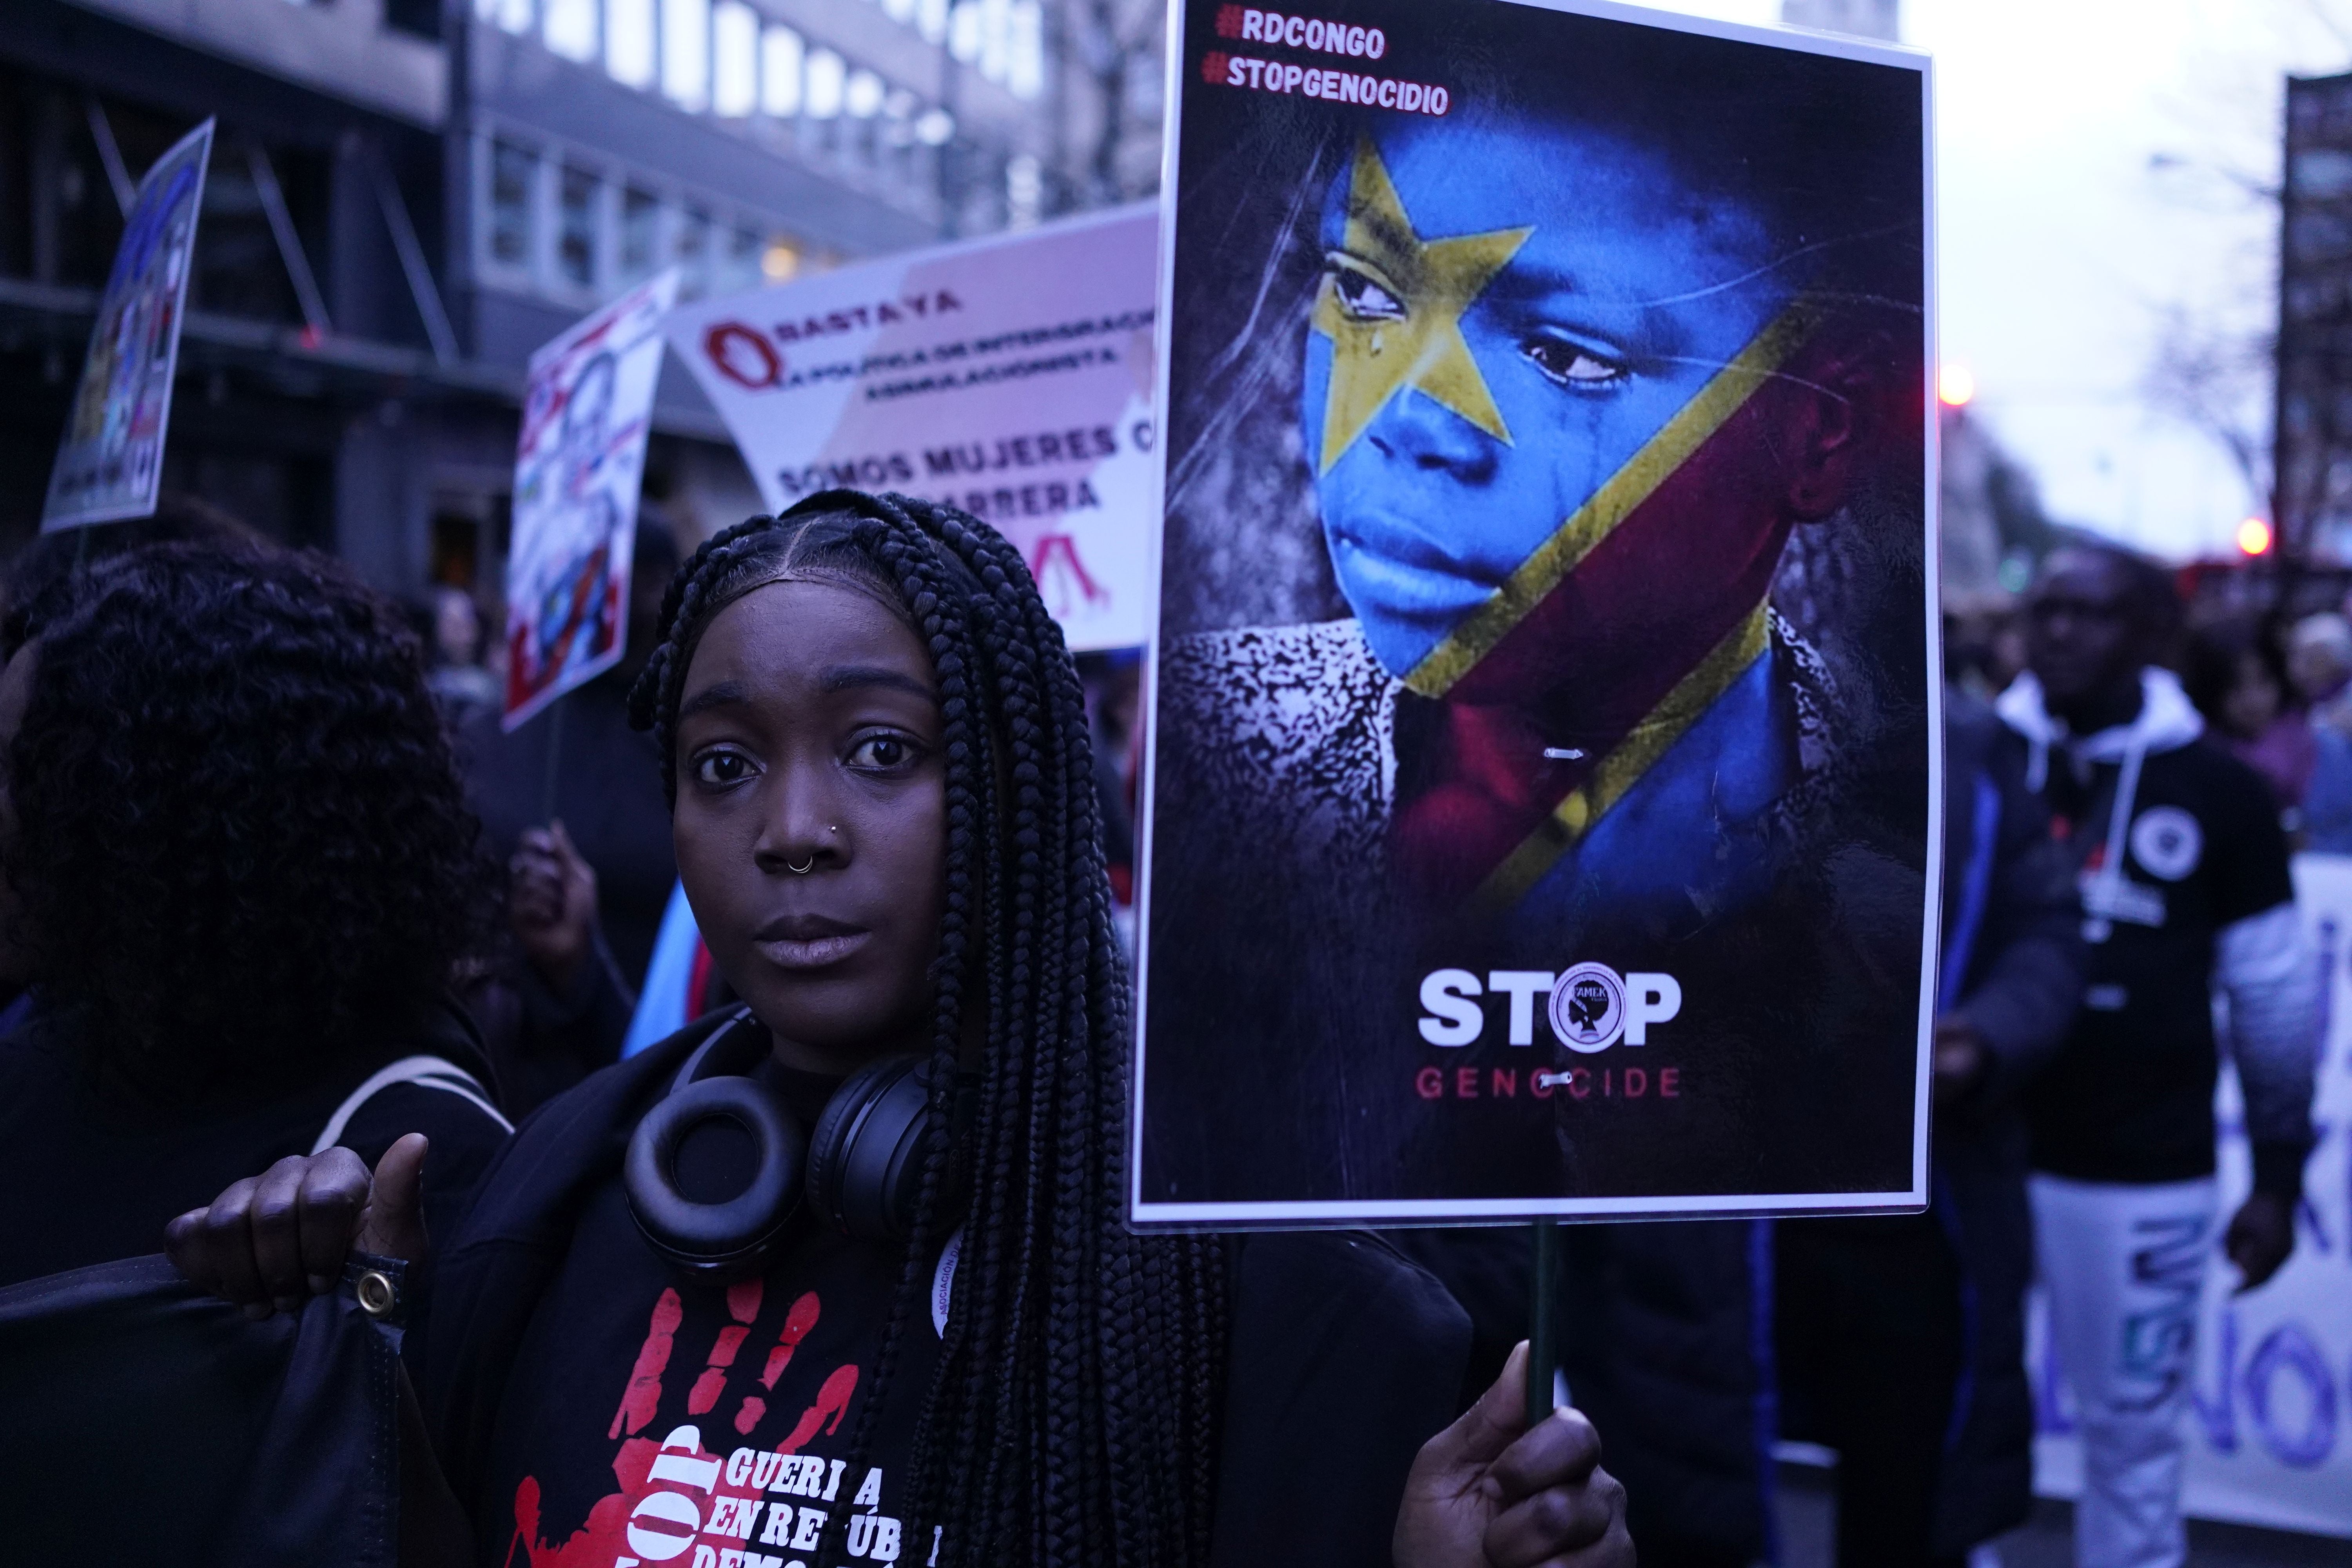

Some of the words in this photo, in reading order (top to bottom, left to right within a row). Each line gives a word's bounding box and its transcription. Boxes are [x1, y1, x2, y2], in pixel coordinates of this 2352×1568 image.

[1216, 3, 1385, 59] #RDCONGO
[1201, 52, 1448, 115] #STOPGENOCIDIO
[779, 453, 913, 494] SOMOS
[924, 425, 1117, 474] MUJERES
[1418, 961, 1682, 1054] STOP
[1416, 1067, 1679, 1098] GENOCIDE
[702, 1495, 764, 1540] EN
